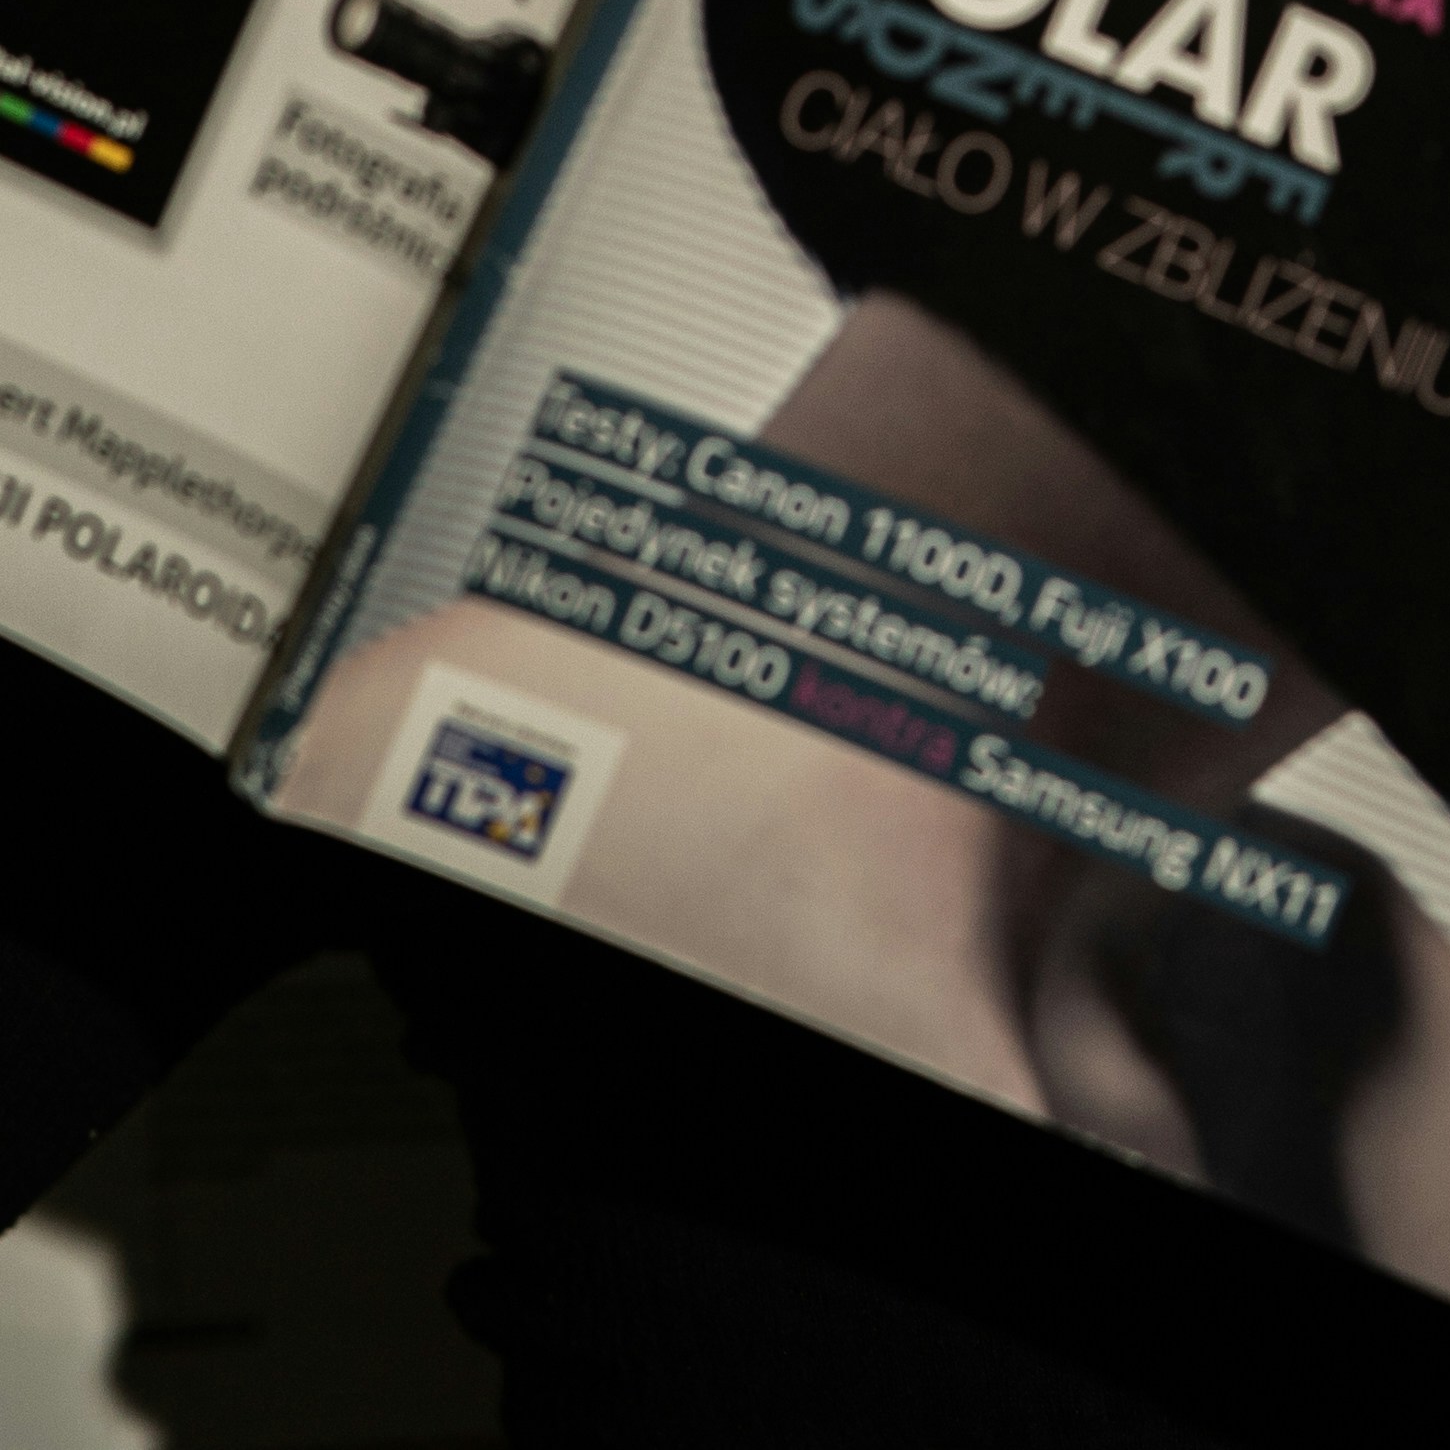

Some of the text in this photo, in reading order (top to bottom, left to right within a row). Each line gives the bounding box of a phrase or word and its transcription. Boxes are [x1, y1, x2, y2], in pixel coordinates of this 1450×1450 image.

[1020, 157, 1112, 250] W
[503, 457, 764, 602] Pojedynek
[684, 436, 852, 542] Canon
[1028, 574, 1136, 670] Fuji
[1126, 619, 1269, 722] X100
[472, 534, 617, 632] Nikon
[618, 590, 794, 702] D5100
[793, 663, 960, 774] kontra
[959, 733, 1199, 895] Samsung
[1204, 834, 1342, 938] NX11
